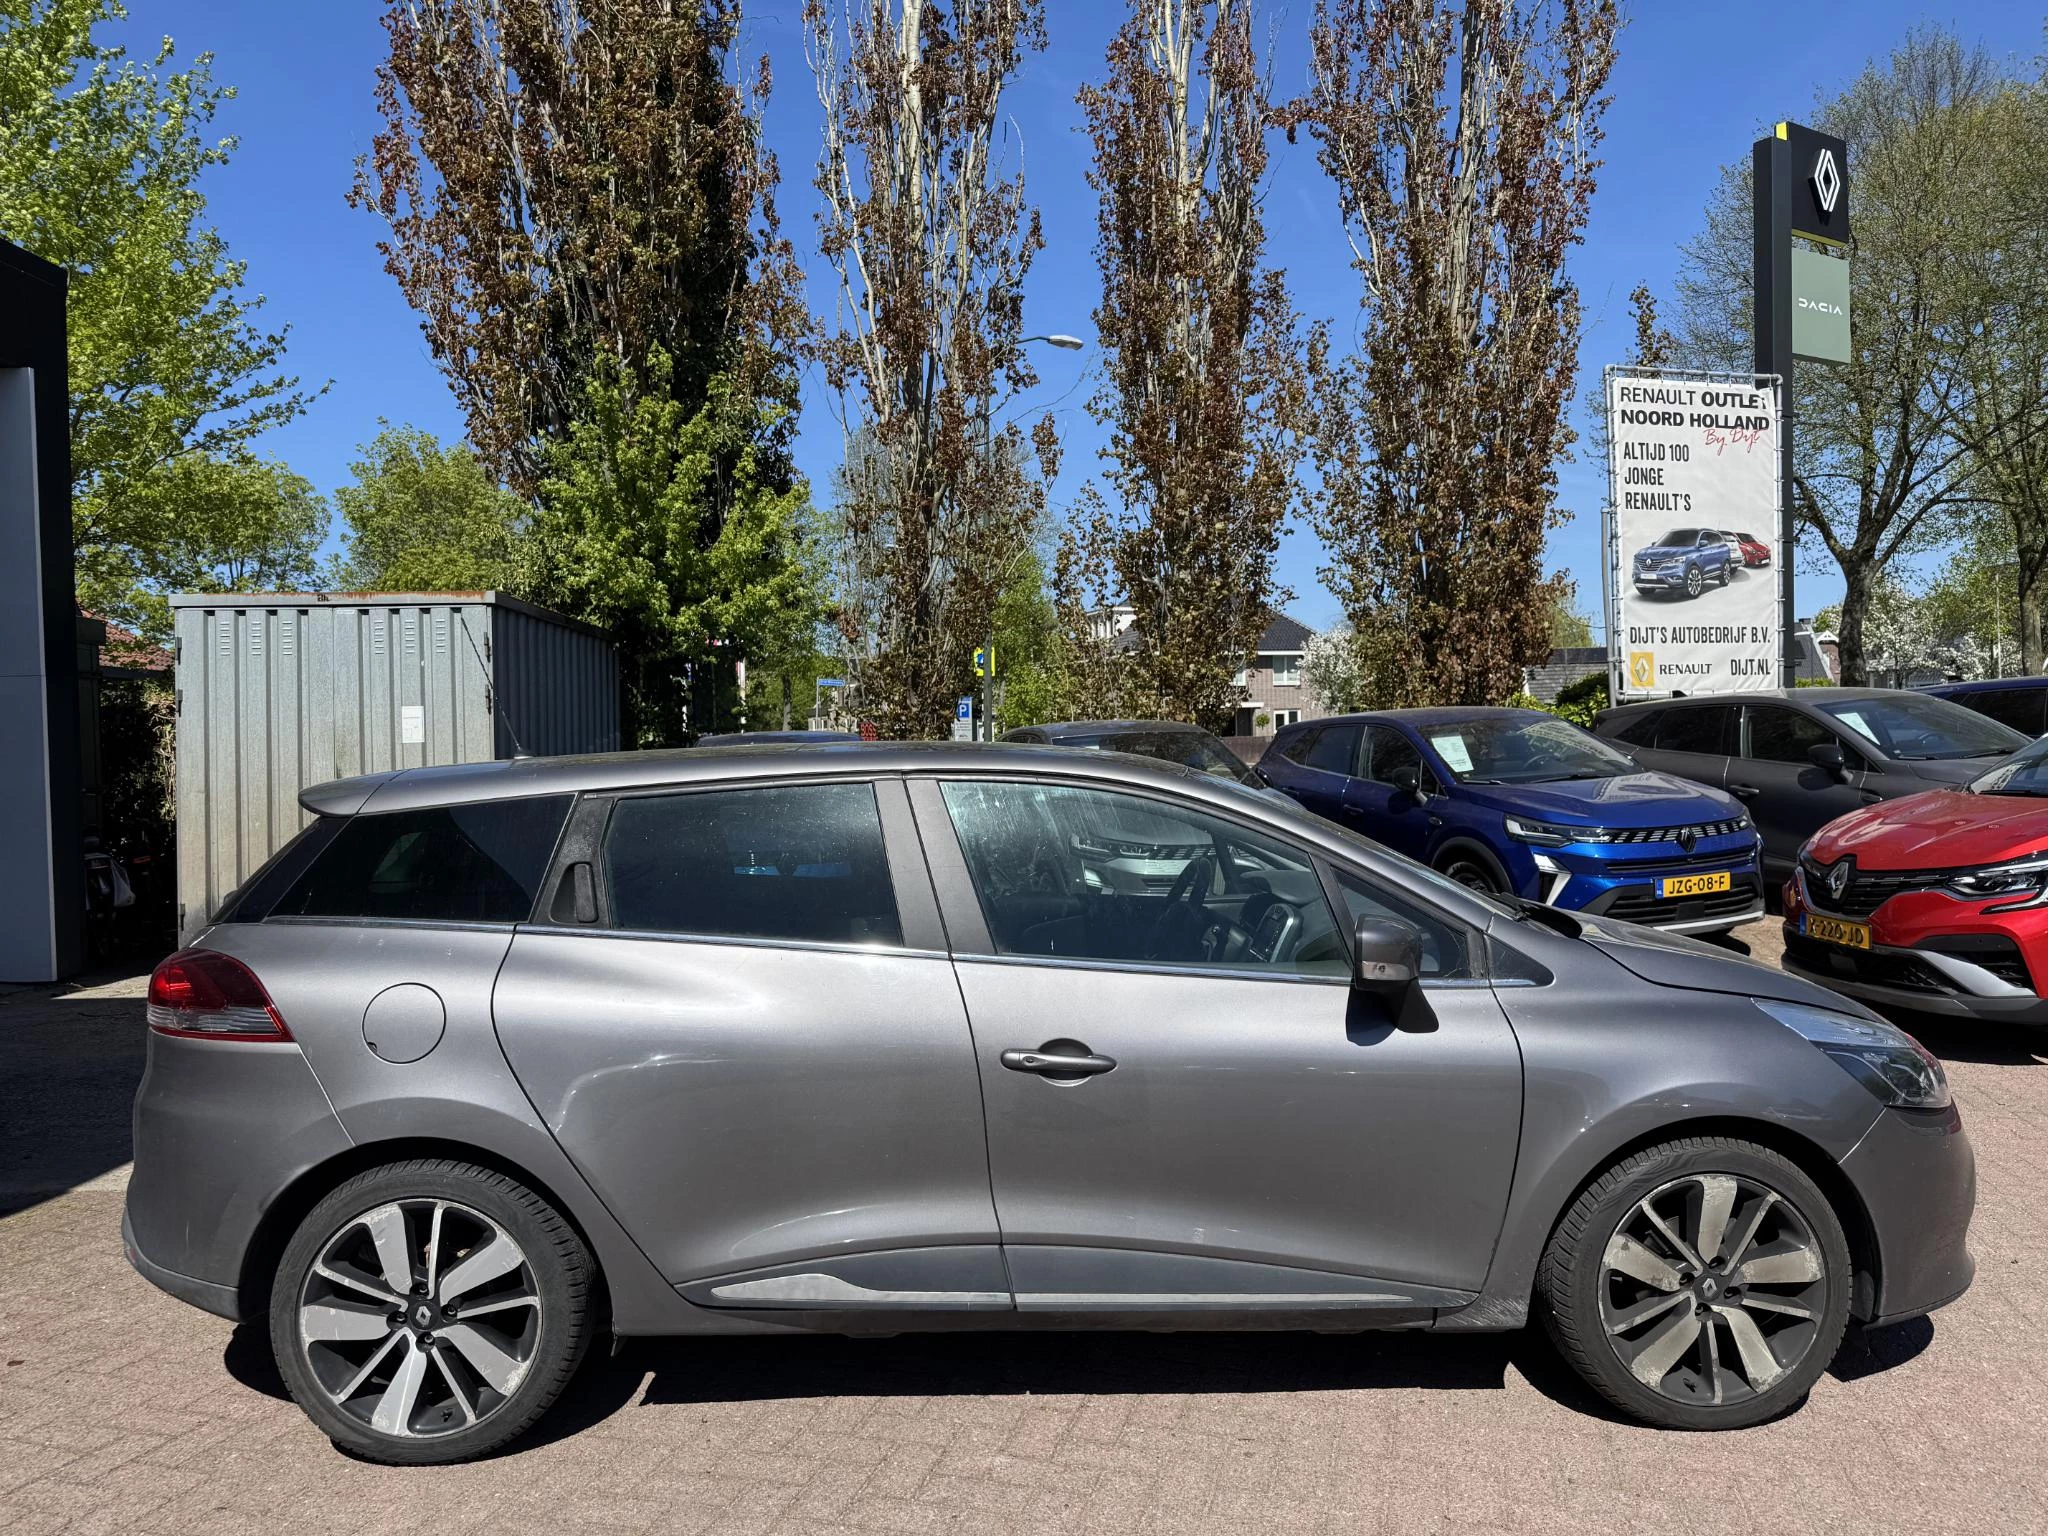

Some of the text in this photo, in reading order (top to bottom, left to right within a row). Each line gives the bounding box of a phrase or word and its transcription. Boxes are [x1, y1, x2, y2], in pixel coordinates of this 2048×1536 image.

[1798, 297, 1842, 315] DACIA
[1620, 387, 1696, 405] RENAULT
[1621, 410, 1770, 431] NOORD HOLLAND
[1704, 428, 1727, 456] By
[1623, 442, 1690, 462] ALTIJD 100
[1624, 467, 1664, 486] JONGE
[1625, 492, 1692, 511] RENAULT'S
[1629, 626, 1771, 644] DIJT'S AUTOBEDRIJF B.V.
[1659, 659, 1771, 676] RENAULT DIJT.NL
[960, 705, 967, 717] P
[1669, 876, 1725, 894] JZG-08-F
[1809, 918, 1864, 944] X-220-JD
